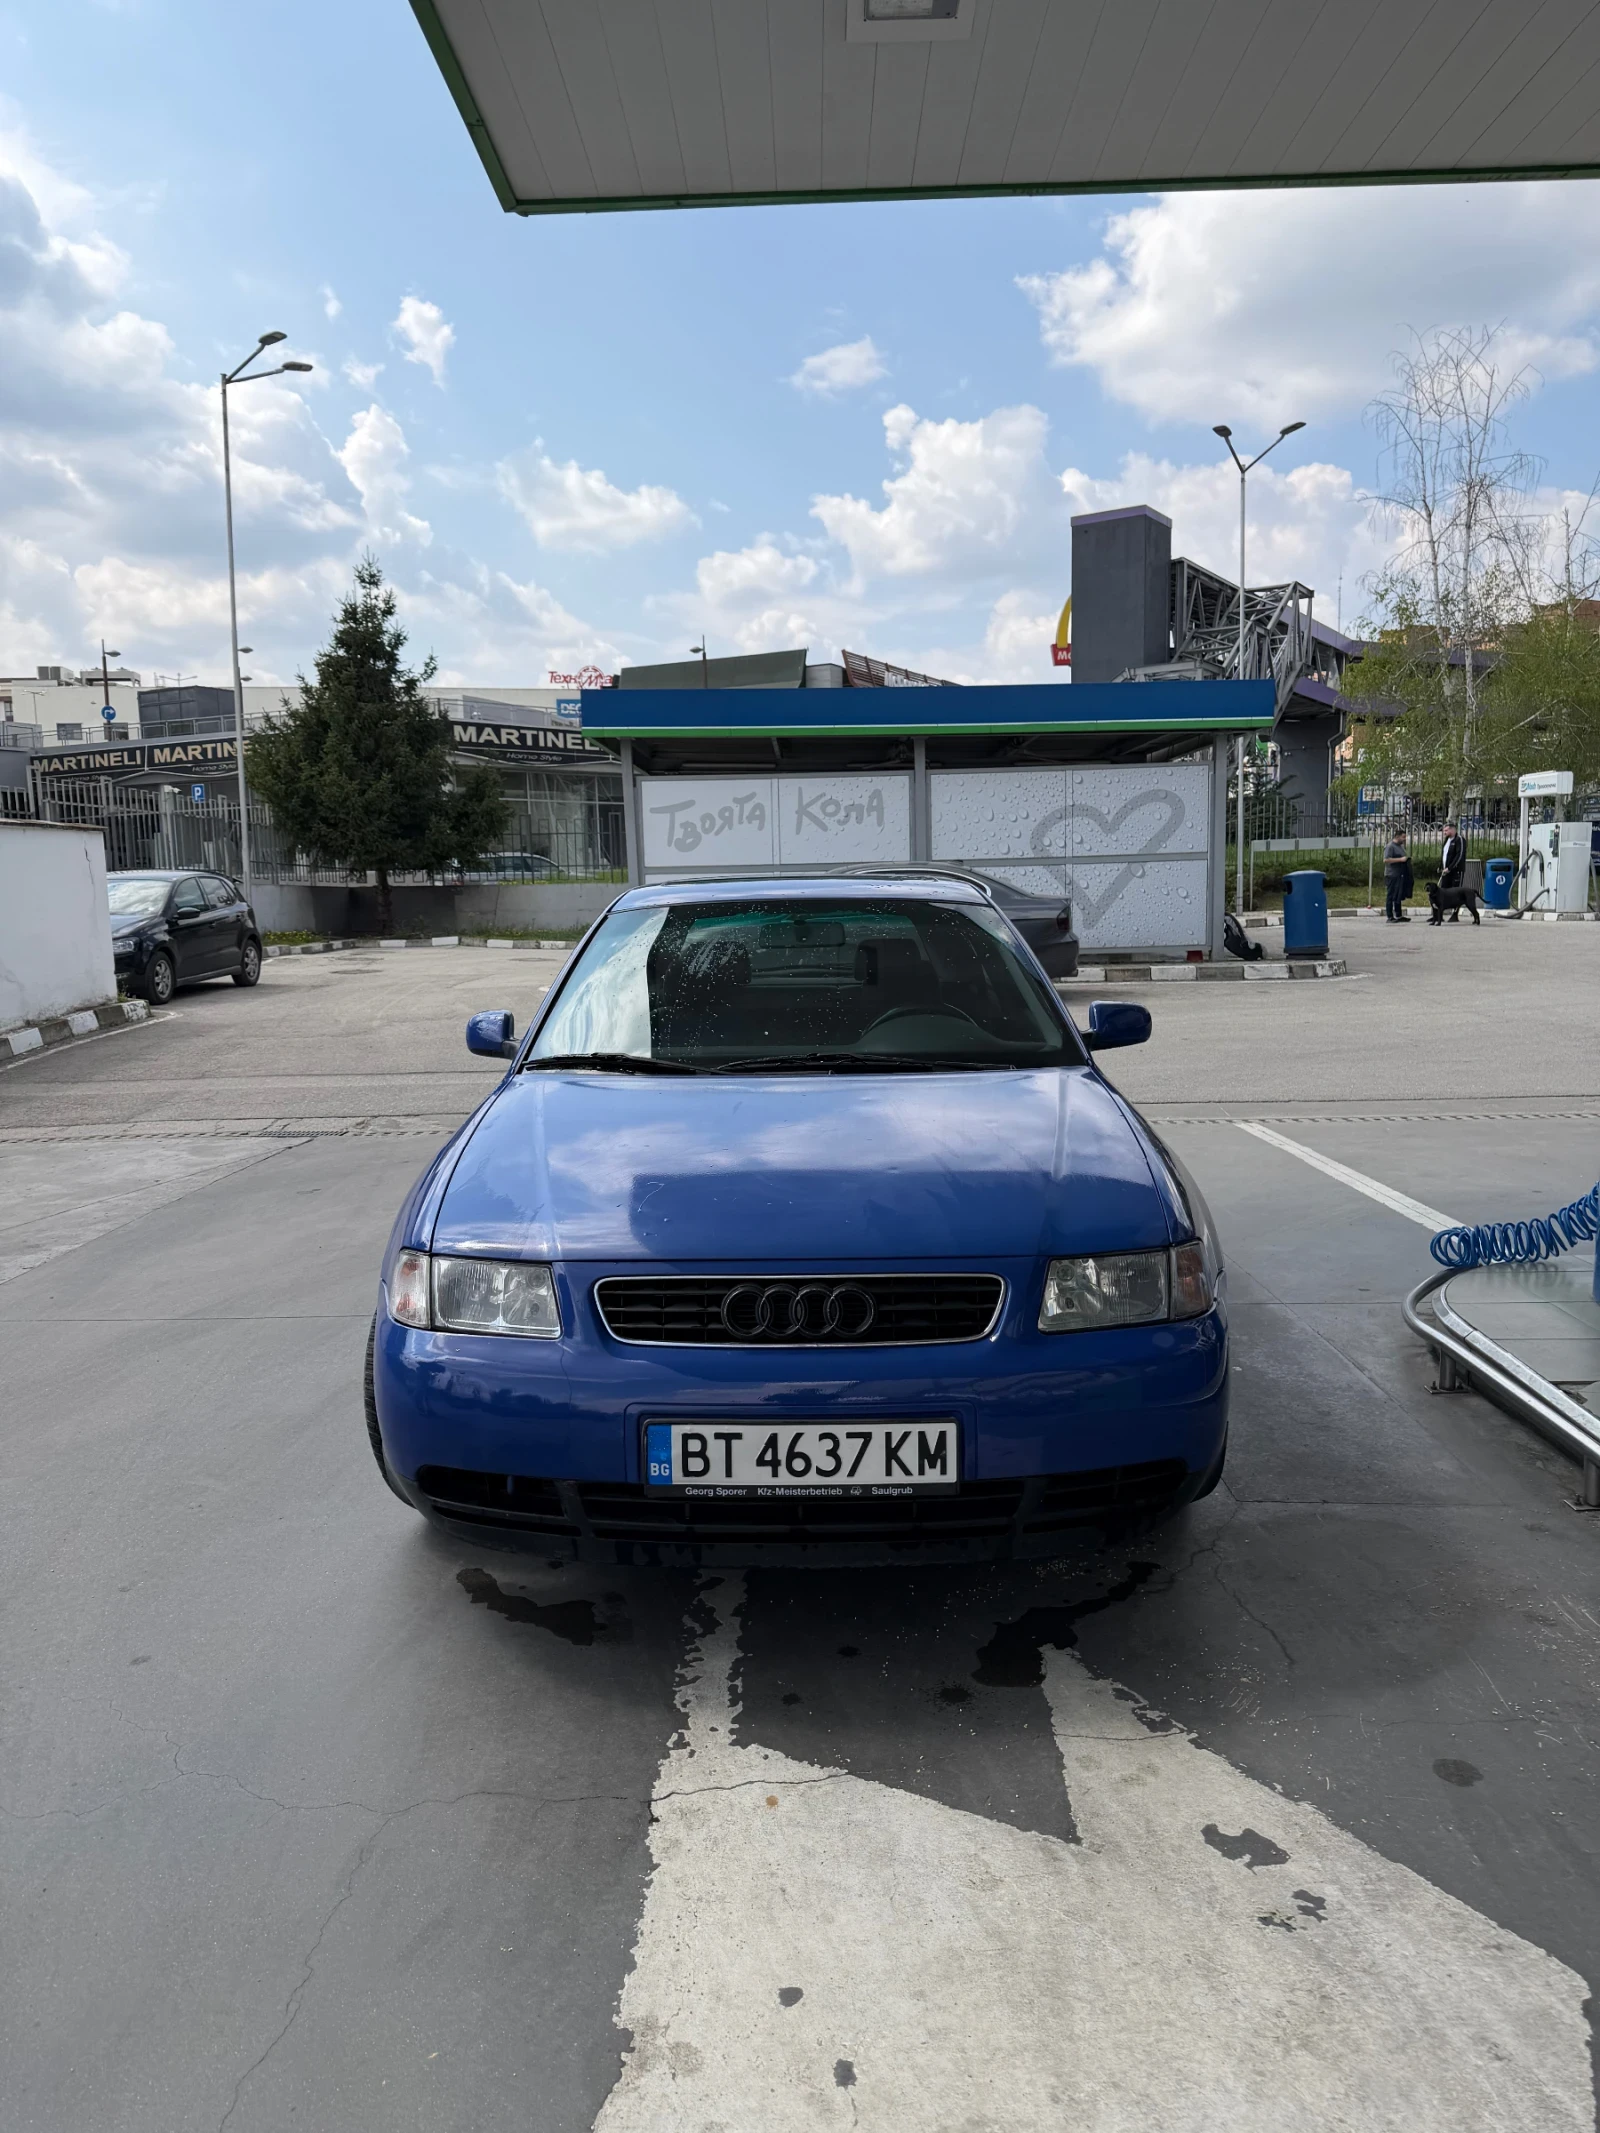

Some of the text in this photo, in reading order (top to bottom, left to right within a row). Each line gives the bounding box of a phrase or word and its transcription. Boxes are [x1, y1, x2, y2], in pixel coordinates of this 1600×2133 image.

[453, 724, 604, 752] MARTINEL
[33, 749, 142, 774] MARTINELI
[506, 752, 538, 760] Home
[194, 786, 202, 801] P
[681, 1430, 947, 1478] BT 4637 KM
[650, 1462, 670, 1476] BG
[685, 1486, 913, 1497] Georg Sporer Kfz-Meisterbetrieb Saulgrub
